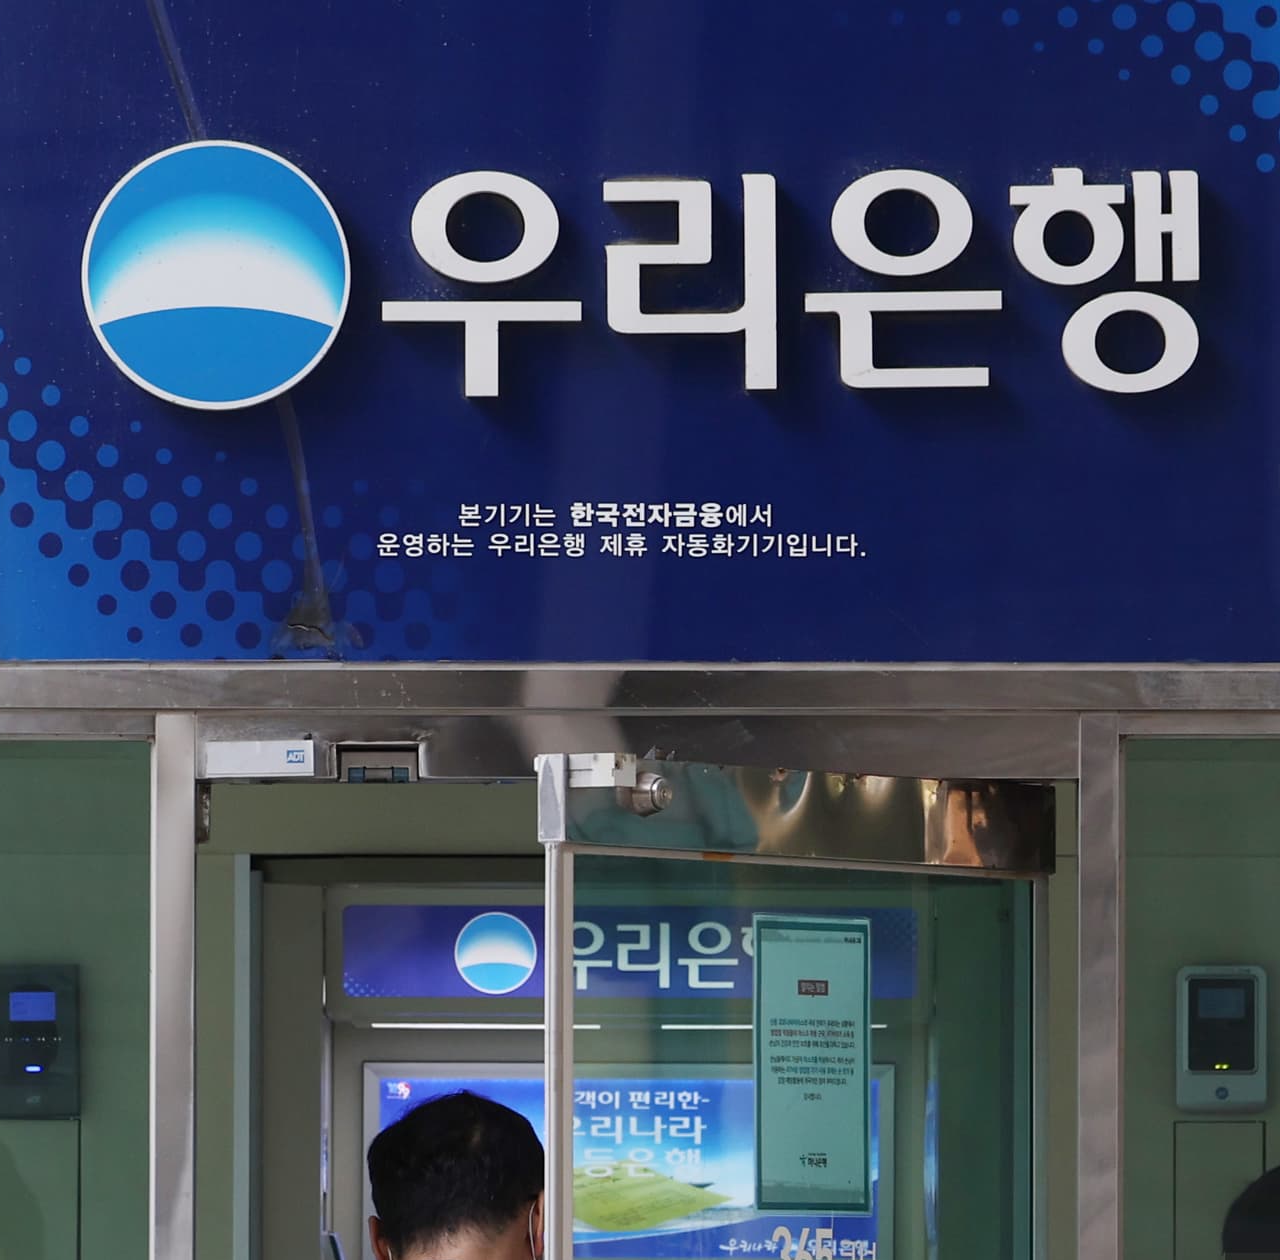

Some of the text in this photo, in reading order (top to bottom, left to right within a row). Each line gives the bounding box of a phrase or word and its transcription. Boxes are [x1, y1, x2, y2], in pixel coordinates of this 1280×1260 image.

[381, 167, 1201, 397] 우리은행
[458, 502, 773, 528] 본기기는 한국전자금융에서
[376, 533, 867, 558] 운영하는 우리은행 제휴 자동화기기입니다.
[287, 750, 304, 763] ADT
[573, 921, 753, 991] 우리은
